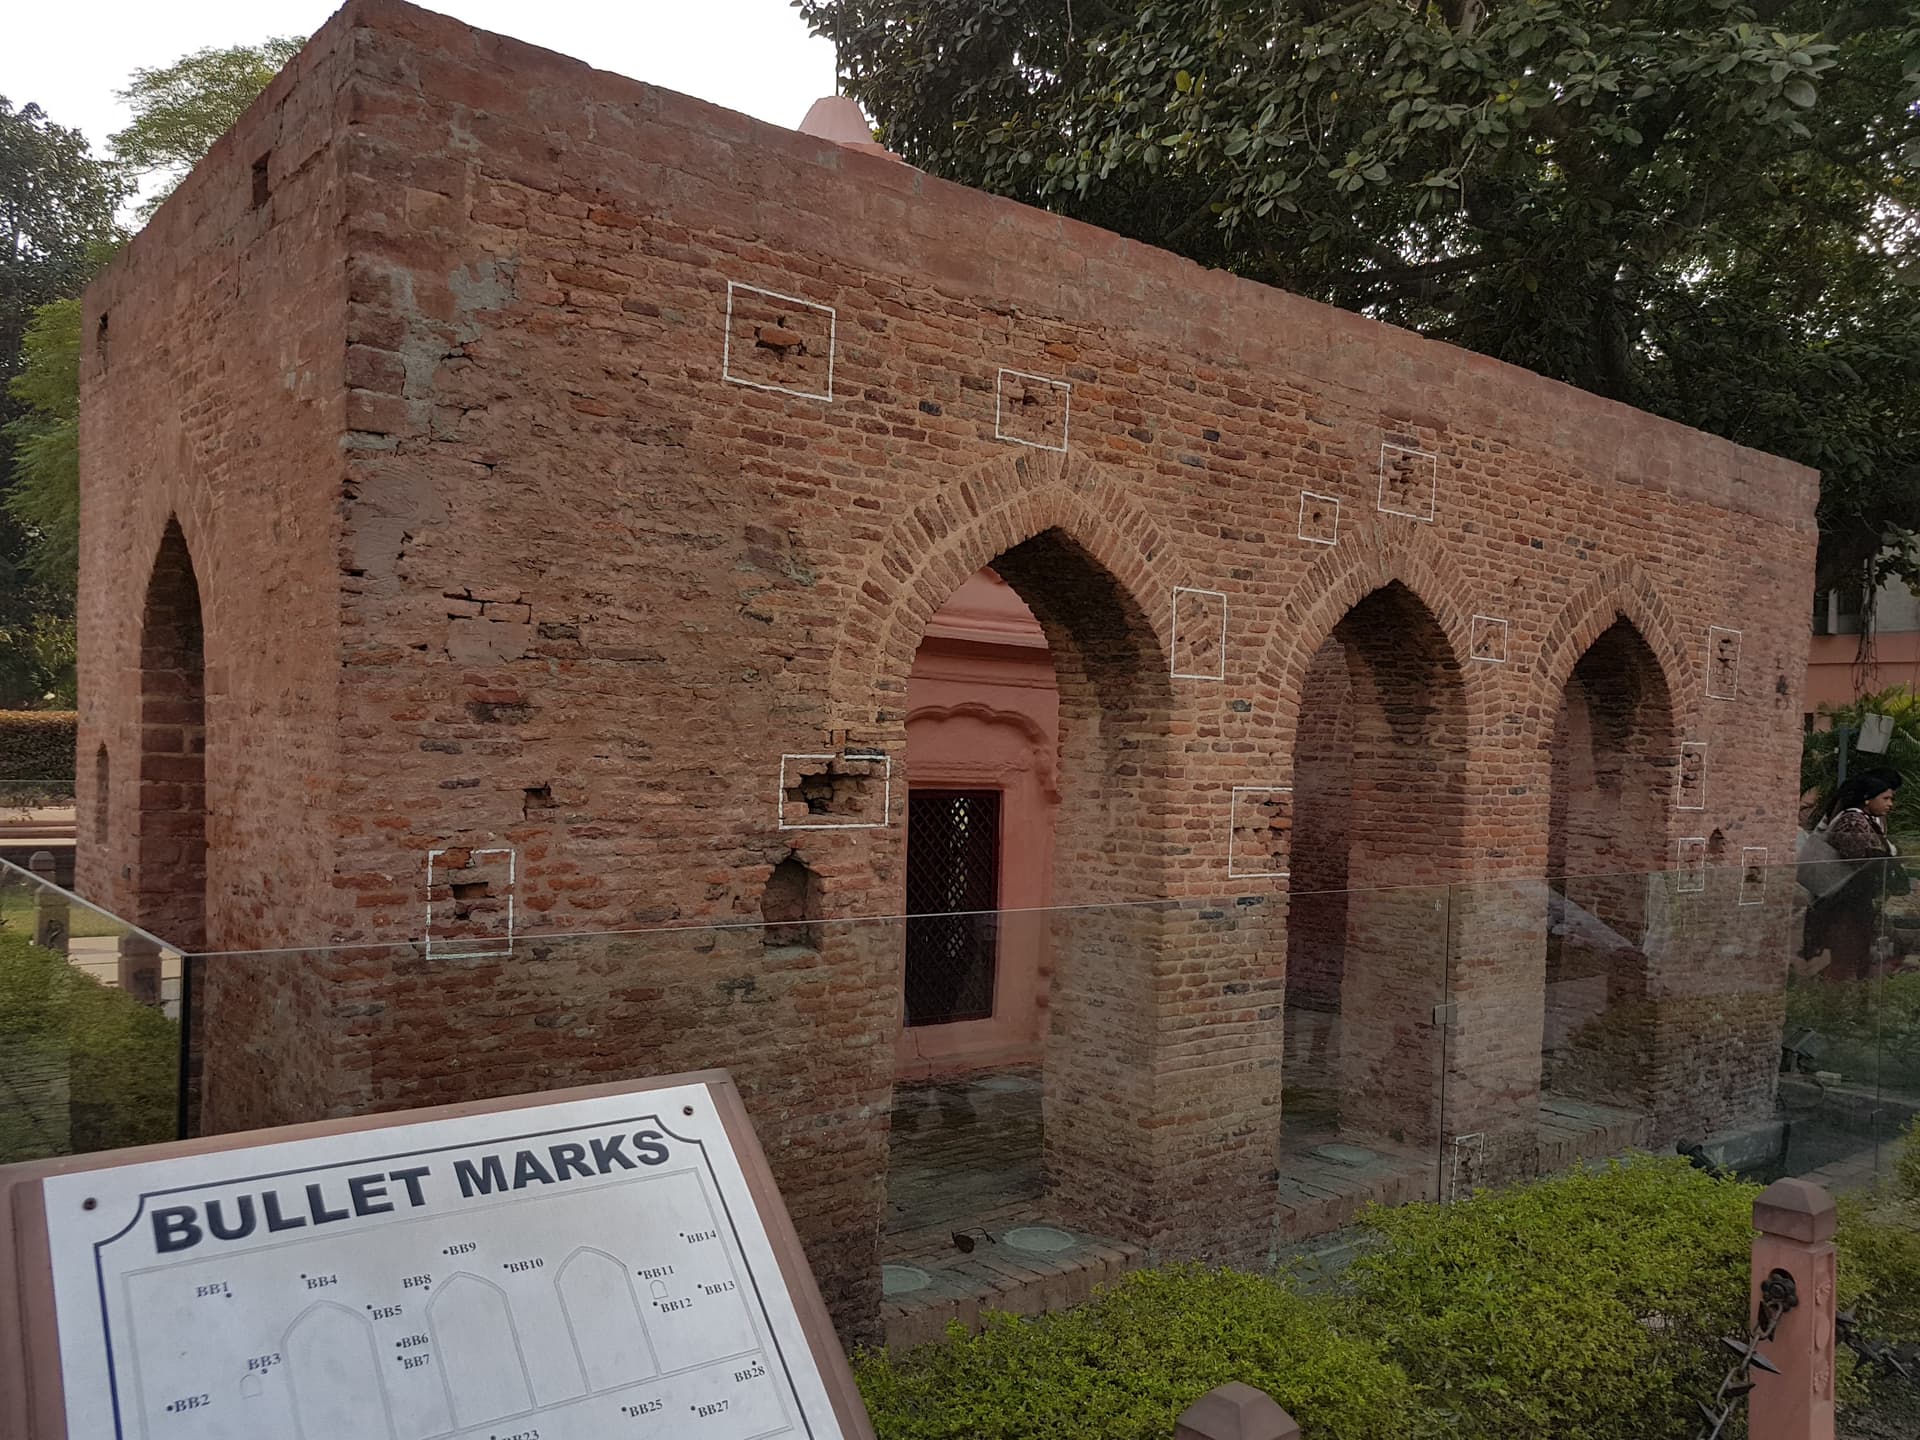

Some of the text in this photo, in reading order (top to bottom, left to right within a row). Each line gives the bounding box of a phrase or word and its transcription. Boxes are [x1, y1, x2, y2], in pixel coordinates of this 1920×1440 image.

[150, 1129, 670, 1254] BULLET MARKS
[687, 1230, 717, 1244] BB14
[449, 1242, 476, 1256] BB9
[509, 1258, 544, 1273] BB10
[643, 1265, 674, 1280] BB11
[307, 1274, 337, 1289] BB4
[403, 1273, 432, 1288] BB8
[704, 1280, 735, 1295] BB13
[197, 1282, 228, 1297] BB1
[372, 1305, 402, 1320] BB5
[660, 1298, 692, 1313] BB12
[402, 1333, 429, 1349] BB6
[249, 1353, 281, 1370] BB3
[404, 1354, 430, 1370] BB7
[734, 1366, 765, 1383] BB28
[174, 1394, 210, 1413] BB2
[630, 1399, 663, 1417] BB25
[699, 1400, 729, 1418] BB27
[502, 1429, 540, 1440] B23
